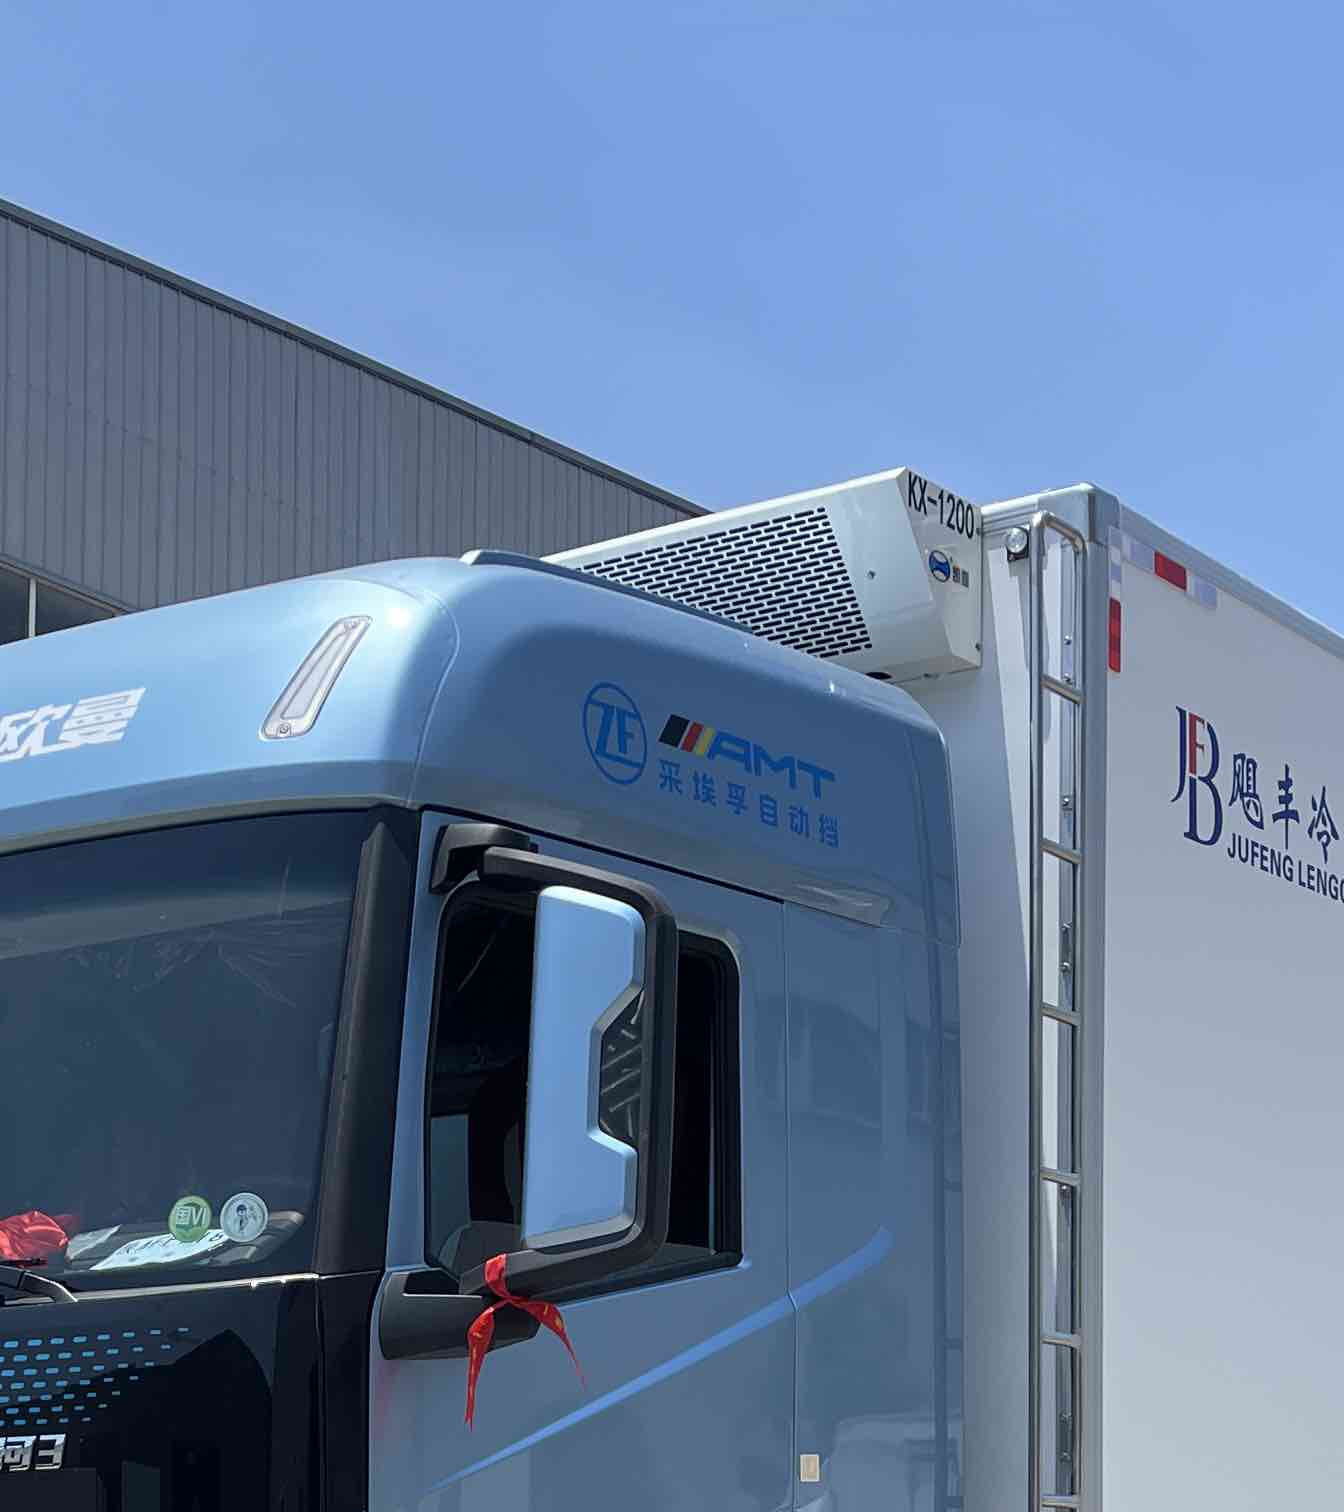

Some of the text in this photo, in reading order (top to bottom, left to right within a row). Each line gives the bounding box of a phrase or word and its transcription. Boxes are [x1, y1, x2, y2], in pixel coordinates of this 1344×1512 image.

[908, 471, 974, 539] KX-1200
[707, 730, 836, 800] AMT
[1227, 832, 1294, 882] JUFENG
